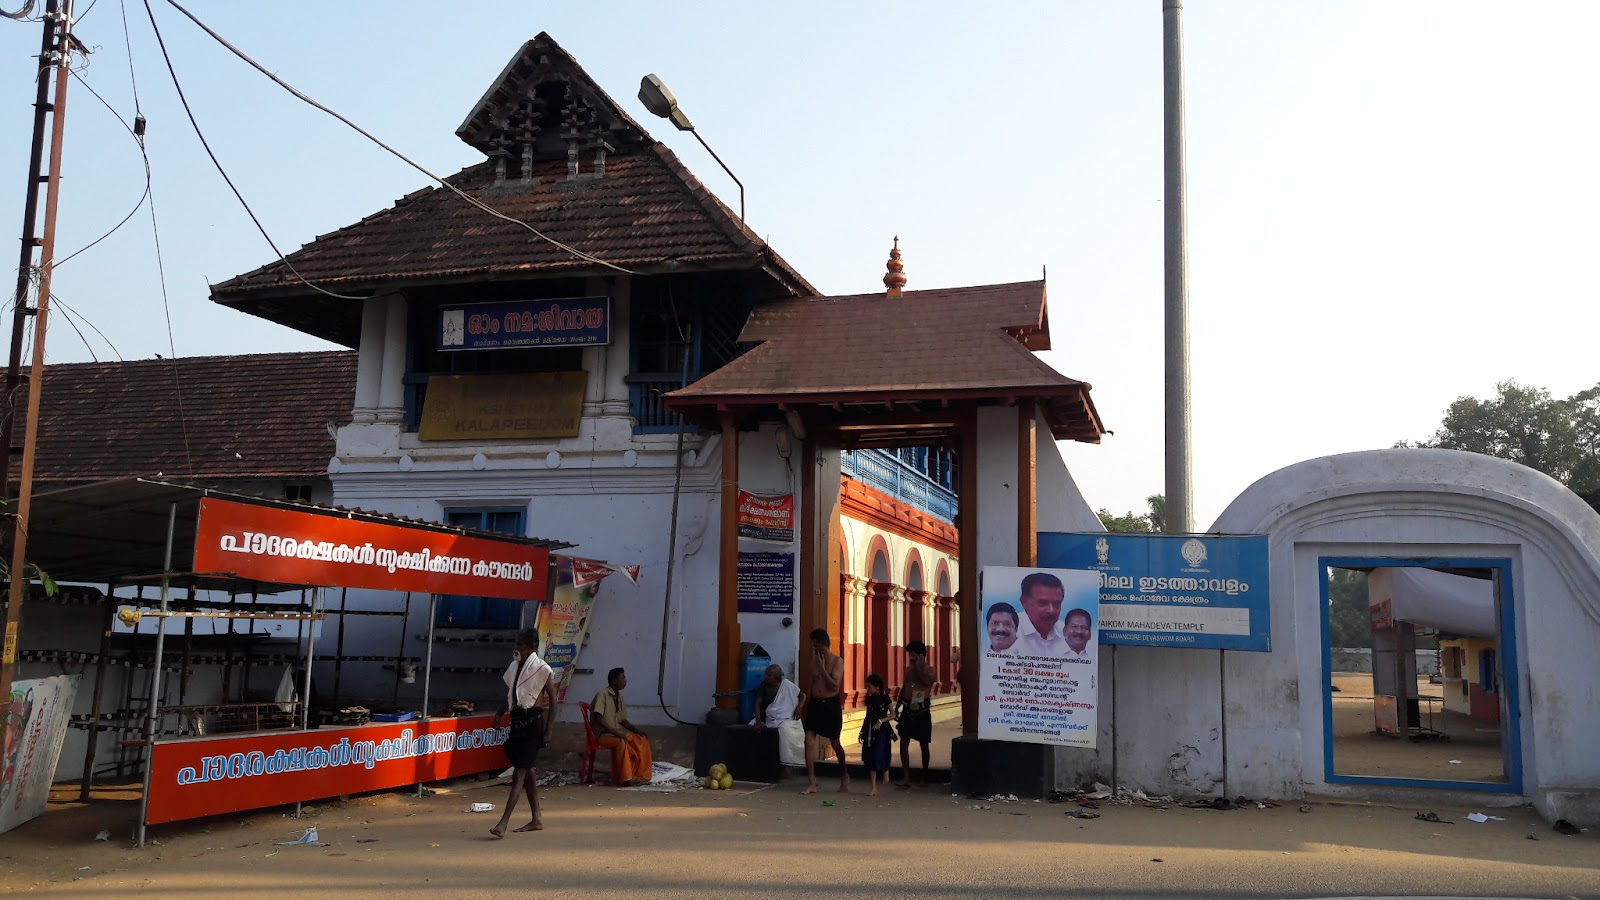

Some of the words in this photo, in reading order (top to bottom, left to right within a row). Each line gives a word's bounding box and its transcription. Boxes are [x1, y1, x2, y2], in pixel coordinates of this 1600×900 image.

[468, 314, 500, 335] ഓം
[220, 531, 374, 565] പാദരക്ഷകൾ
[376, 547, 471, 574] സൂക്ഷിക്കുന്ന
[1139, 576, 1249, 595] ഇടത്താവളം
[1129, 594, 1170, 603] മഹാദേവ
[1127, 621, 1172, 630] MAHADEVA
[1173, 622, 1205, 631] TEMPLE
[1142, 635, 1175, 643] DEVASWOM
[1023, 668, 1034, 676] 30
[177, 738, 351, 785] പാദരക്ഷകൾ
[352, 728, 457, 769] സൂക്ഷിക്കുന്ന
